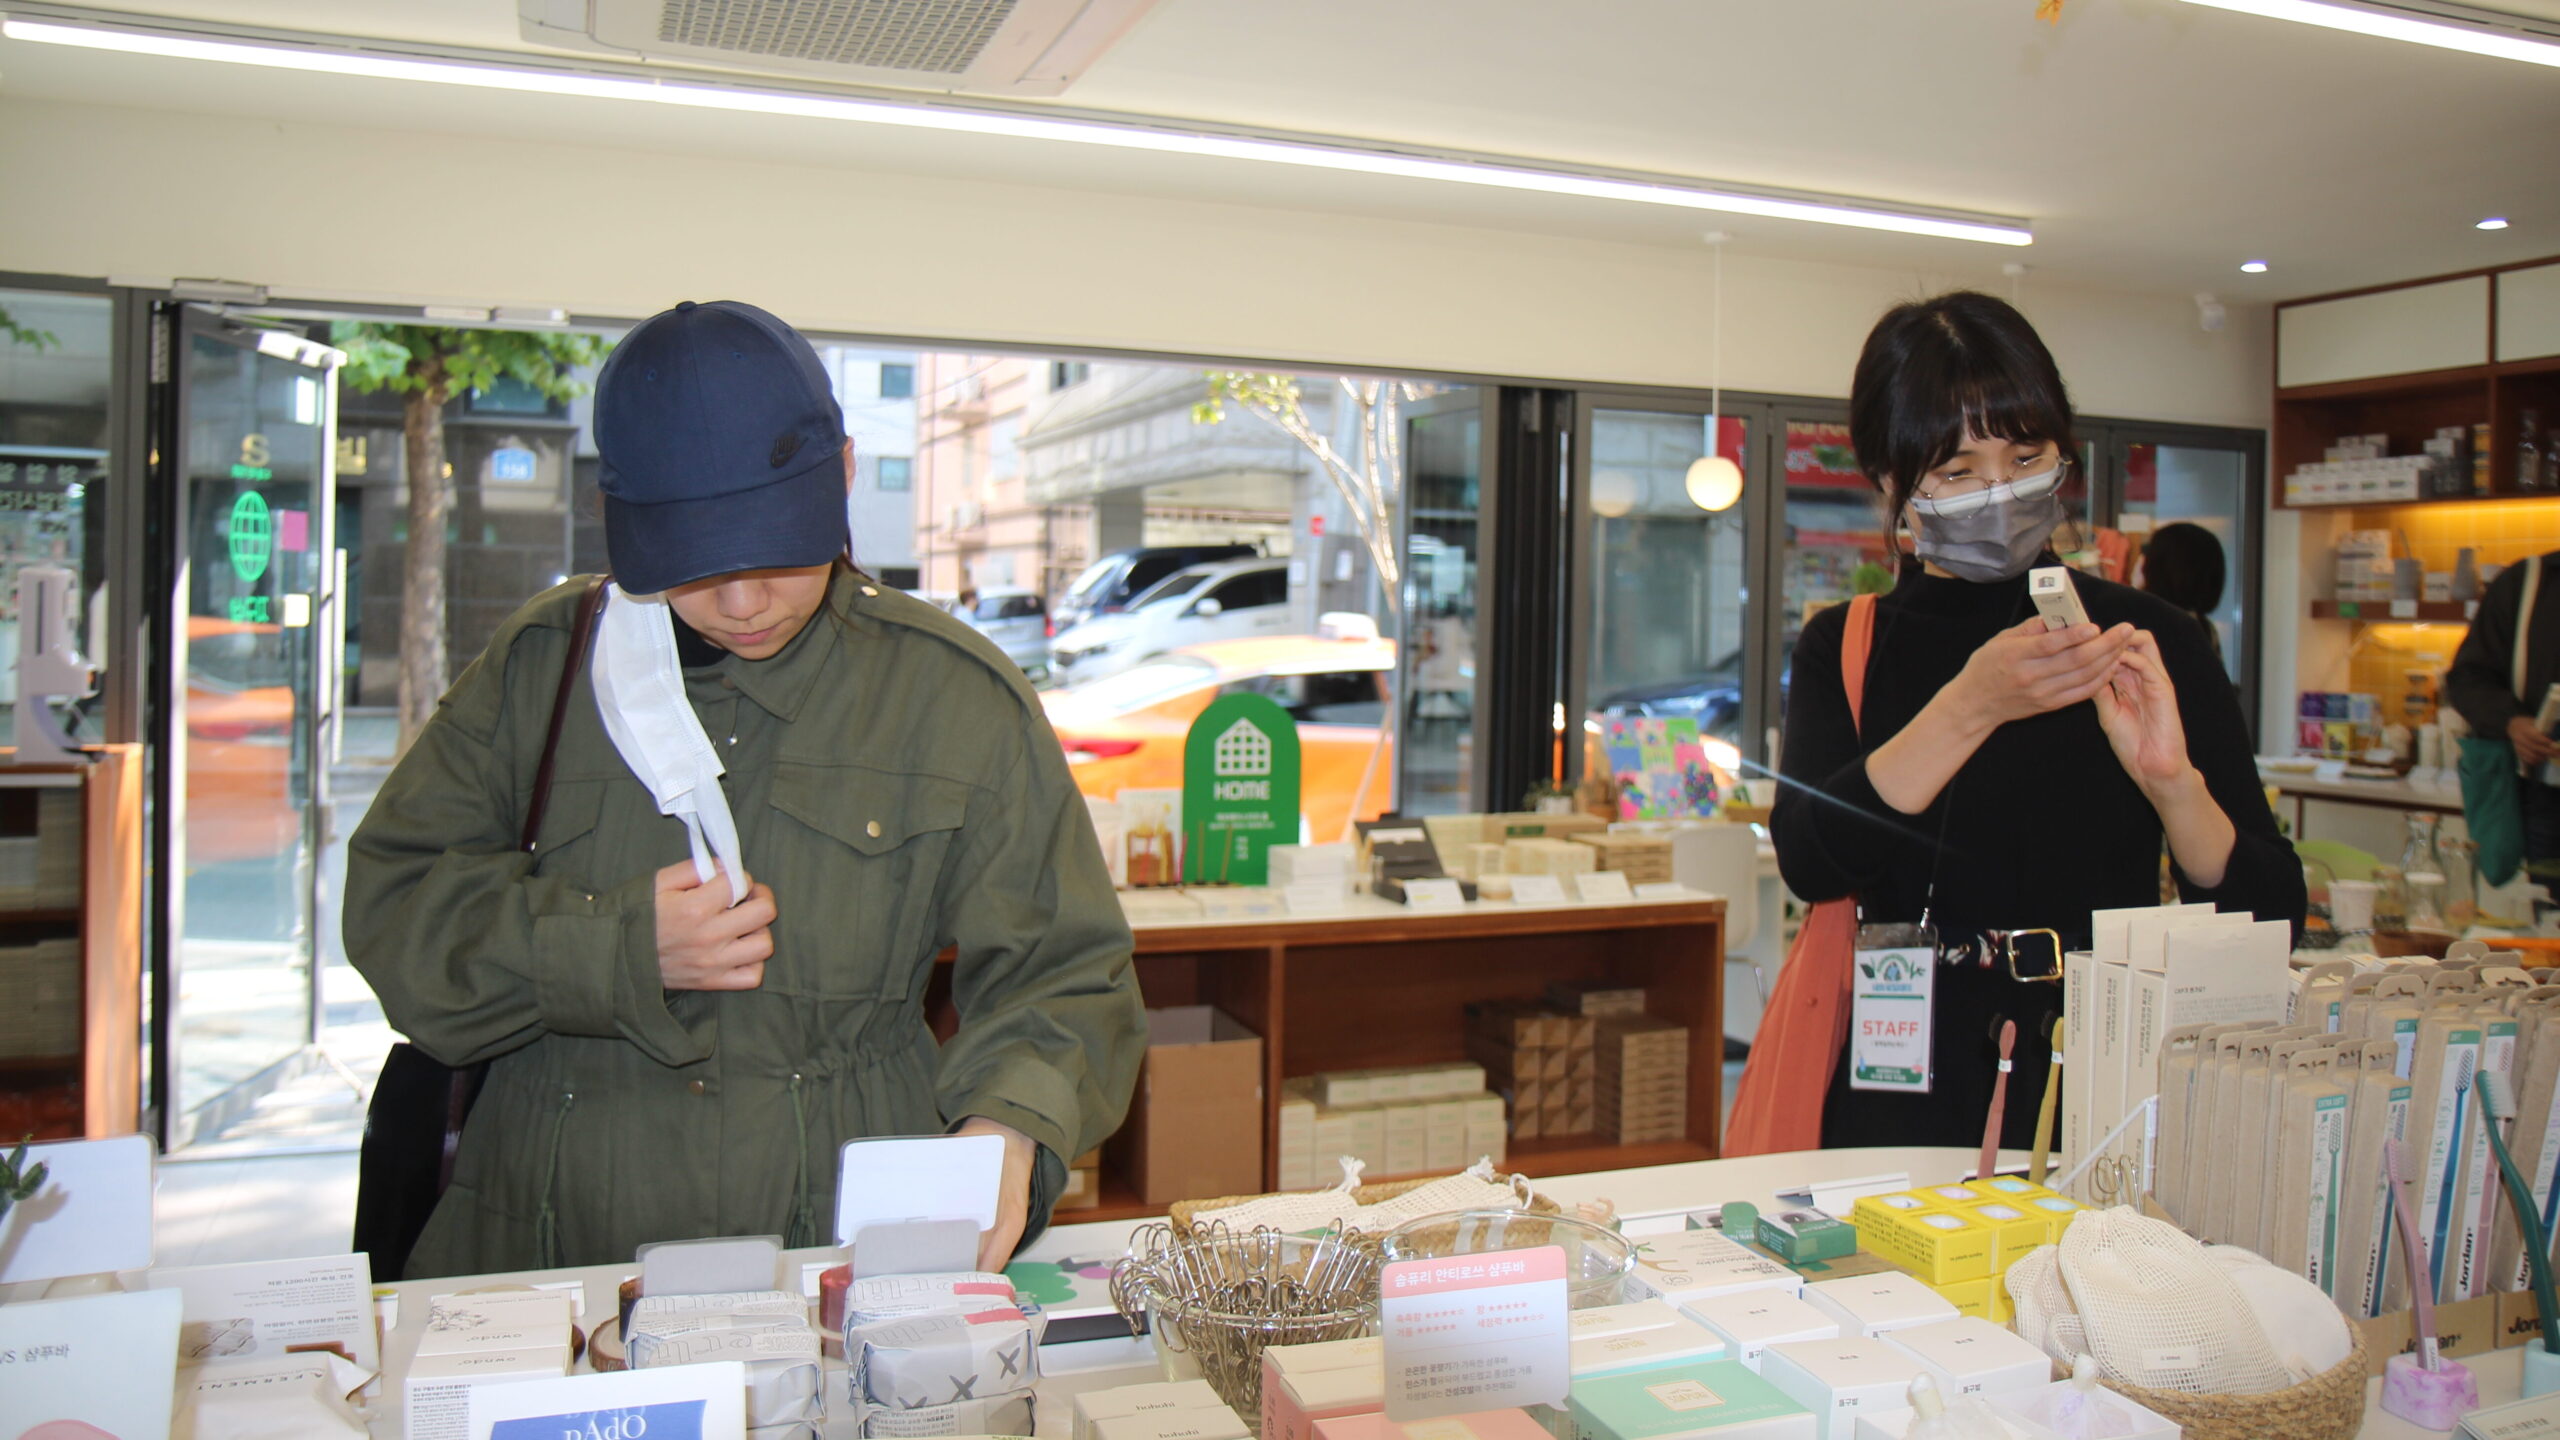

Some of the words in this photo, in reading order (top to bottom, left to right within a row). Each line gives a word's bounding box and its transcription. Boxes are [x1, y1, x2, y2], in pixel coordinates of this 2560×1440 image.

[1213, 780, 1271, 801] HOME
[1862, 1020, 1920, 1037] STAFF
[1436, 1264, 1485, 1282] 안티로쓰
[1488, 1260, 1526, 1277] 샴푸바
[2460, 1232, 2473, 1291] Jordan
[2362, 1247, 2377, 1315] Jordan
[25, 1344, 70, 1362] 샴푸바
[2400, 1334, 2457, 1354] Joan
